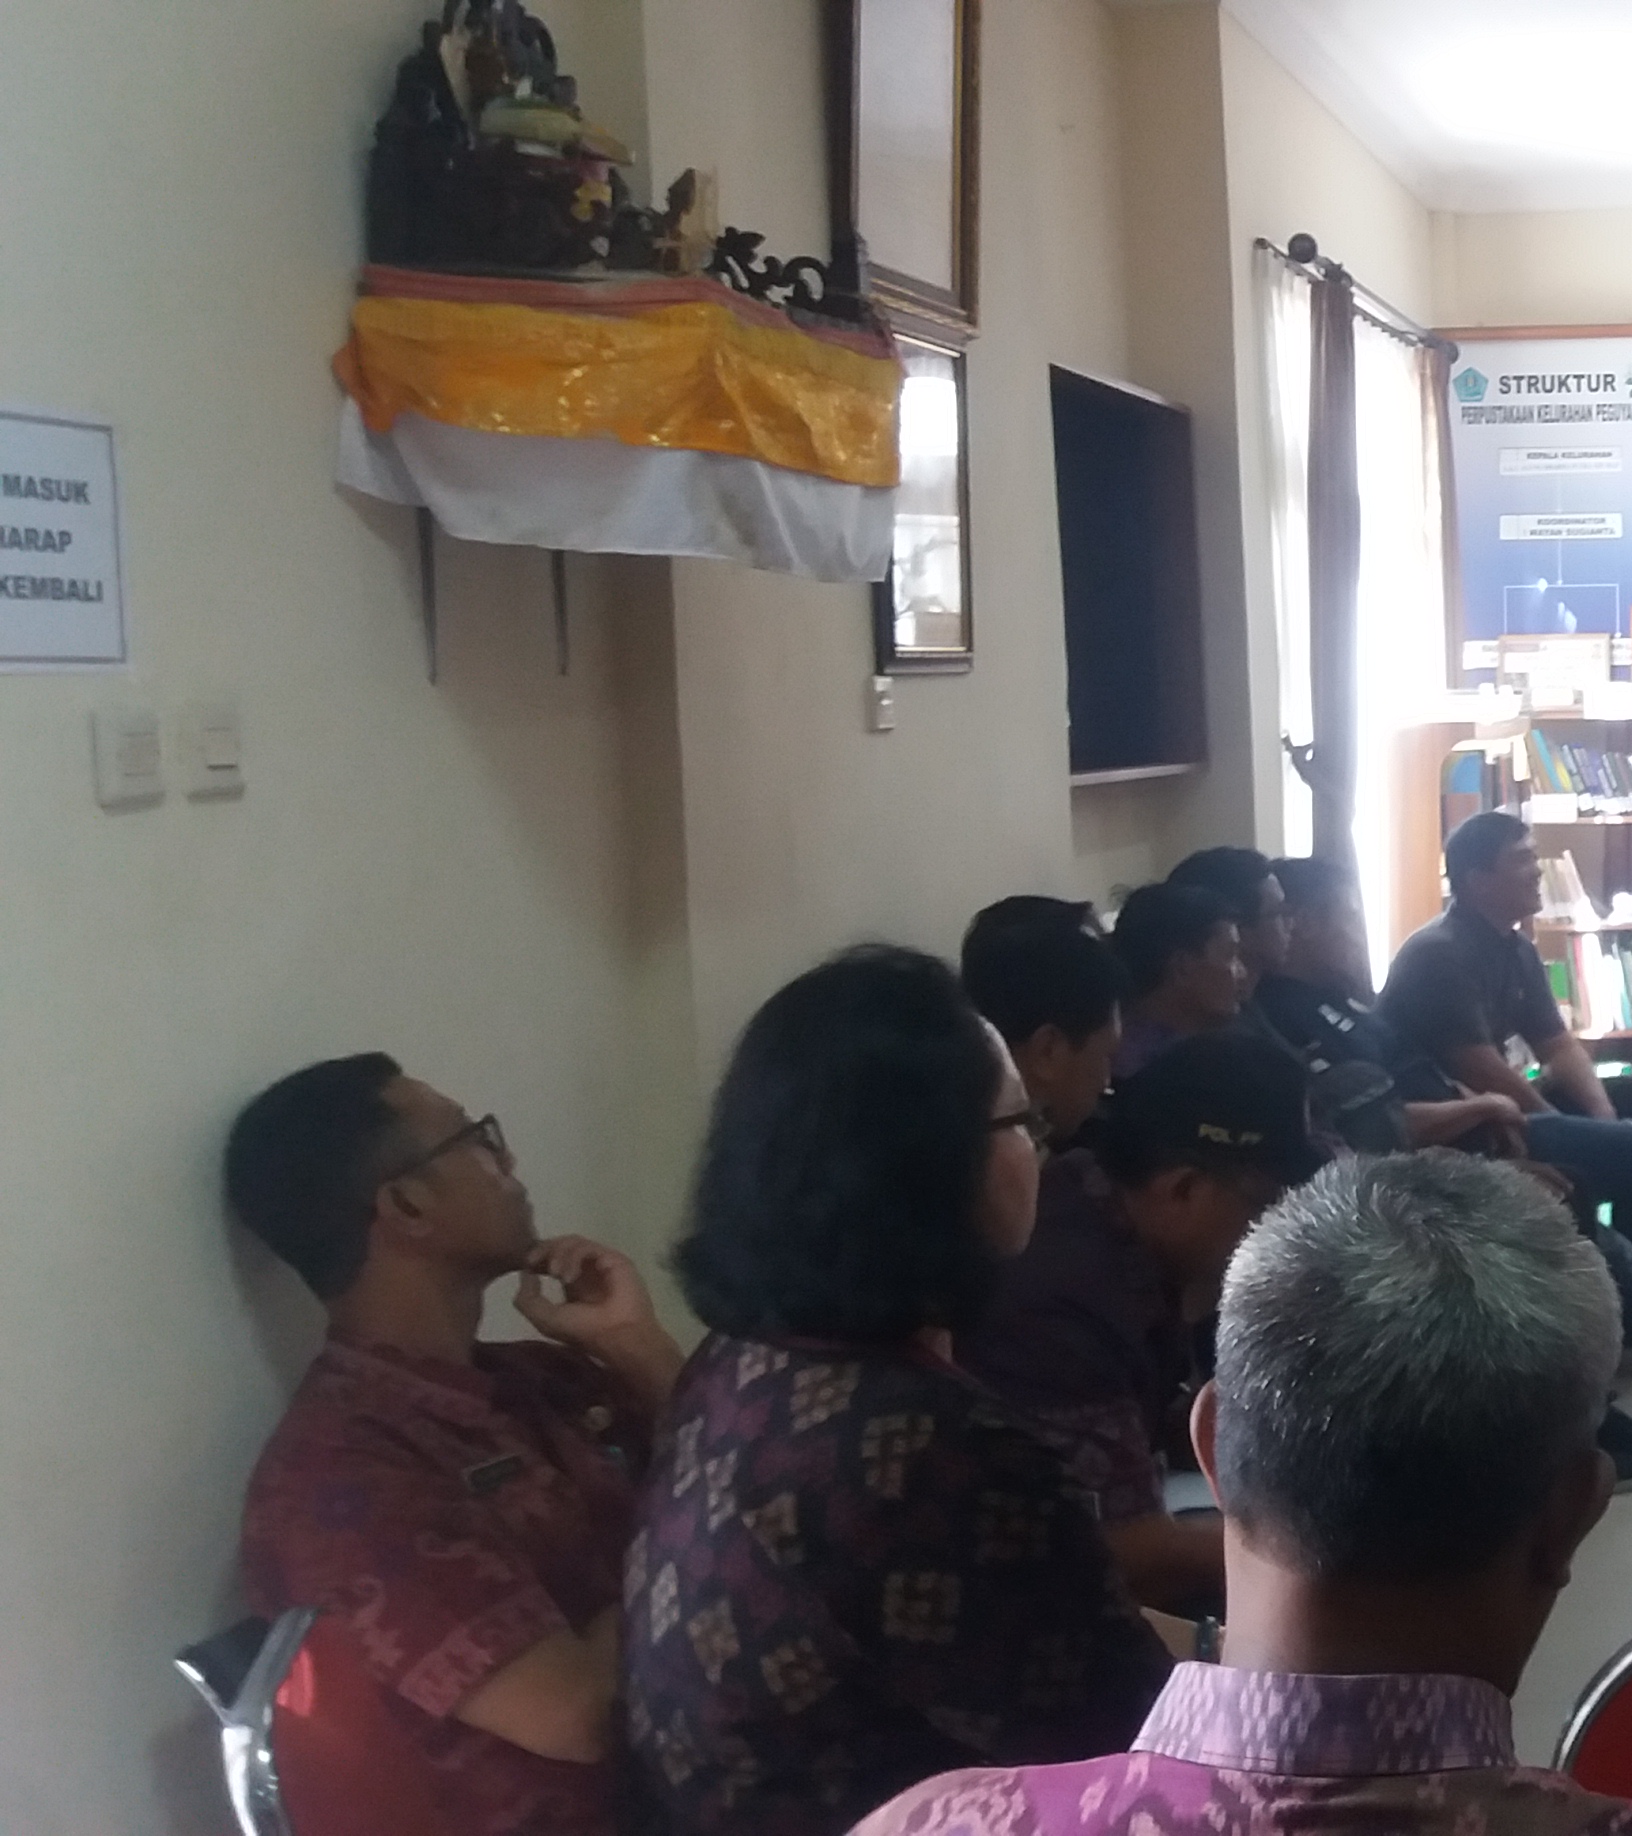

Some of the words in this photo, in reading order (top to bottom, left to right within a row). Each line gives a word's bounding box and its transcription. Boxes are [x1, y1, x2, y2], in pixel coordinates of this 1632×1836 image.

[1498, 373, 1617, 395] STRUKTUR
[1537, 403, 1594, 424] KELURAHAN
[2, 474, 91, 504] MASUK
